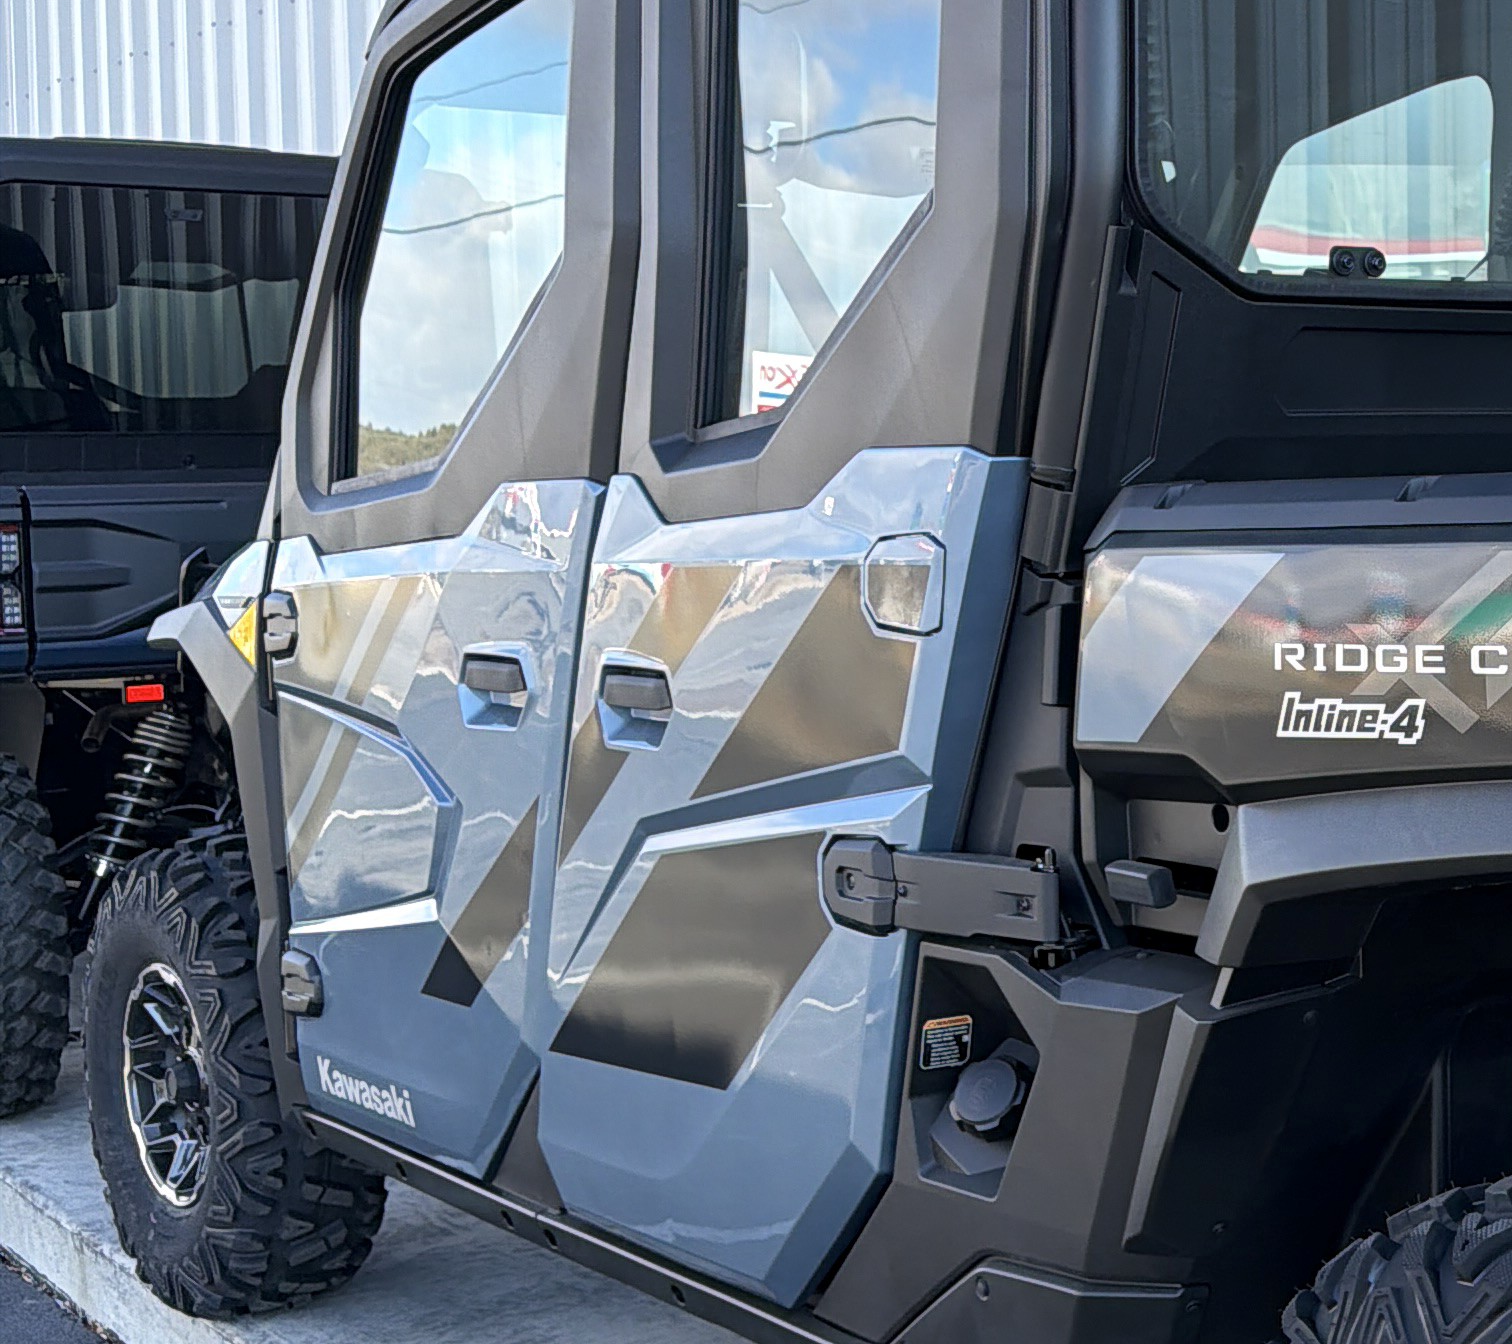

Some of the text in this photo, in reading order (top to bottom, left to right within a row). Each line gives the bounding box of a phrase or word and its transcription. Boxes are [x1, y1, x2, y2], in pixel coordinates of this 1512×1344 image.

[1273, 642, 1446, 673] RIDGE
[1276, 691, 1426, 745] Inline-4
[316, 1055, 416, 1128] Kawasaki
